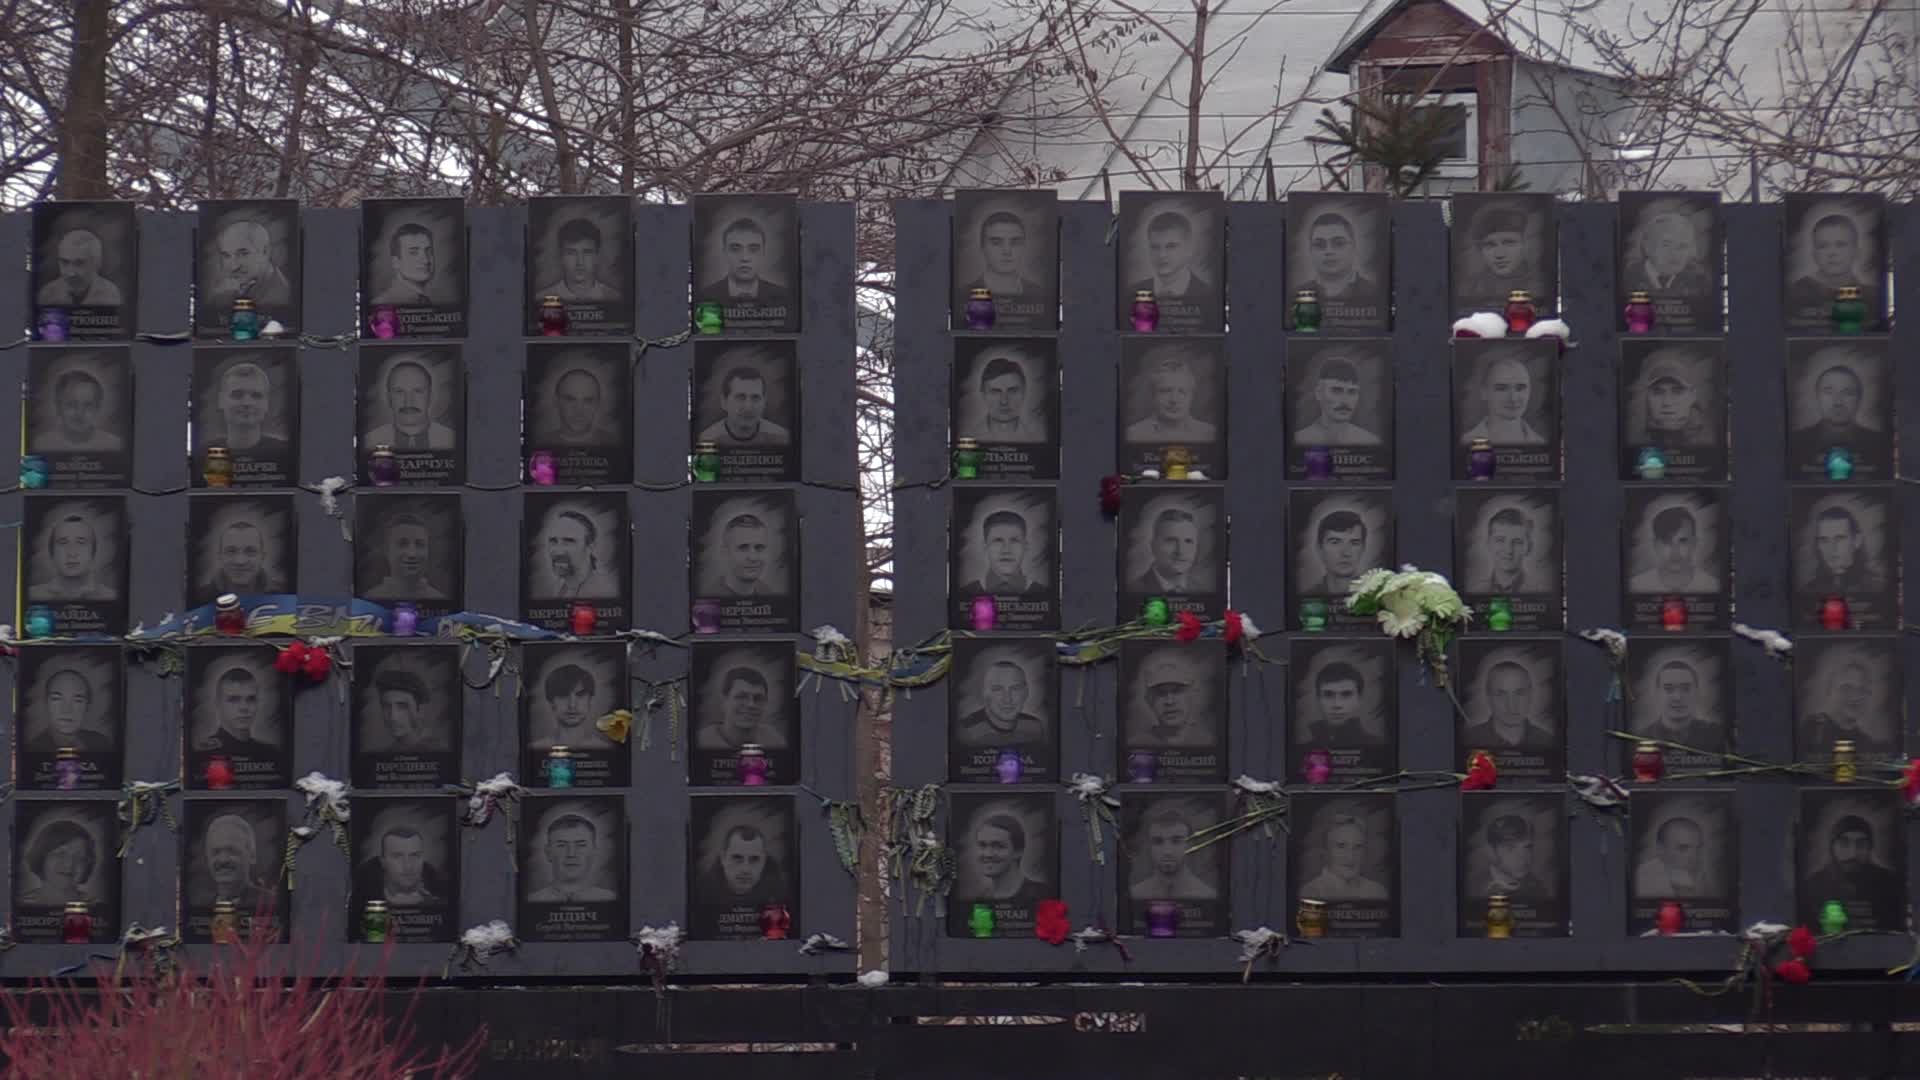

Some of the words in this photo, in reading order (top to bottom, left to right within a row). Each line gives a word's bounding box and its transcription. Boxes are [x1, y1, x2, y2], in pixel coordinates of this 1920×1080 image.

[983, 452, 1029, 463] ЛЬКІВ
[399, 459, 455, 470] ДАРЧУК
[1072, 1011, 1147, 1033] СУМИ
